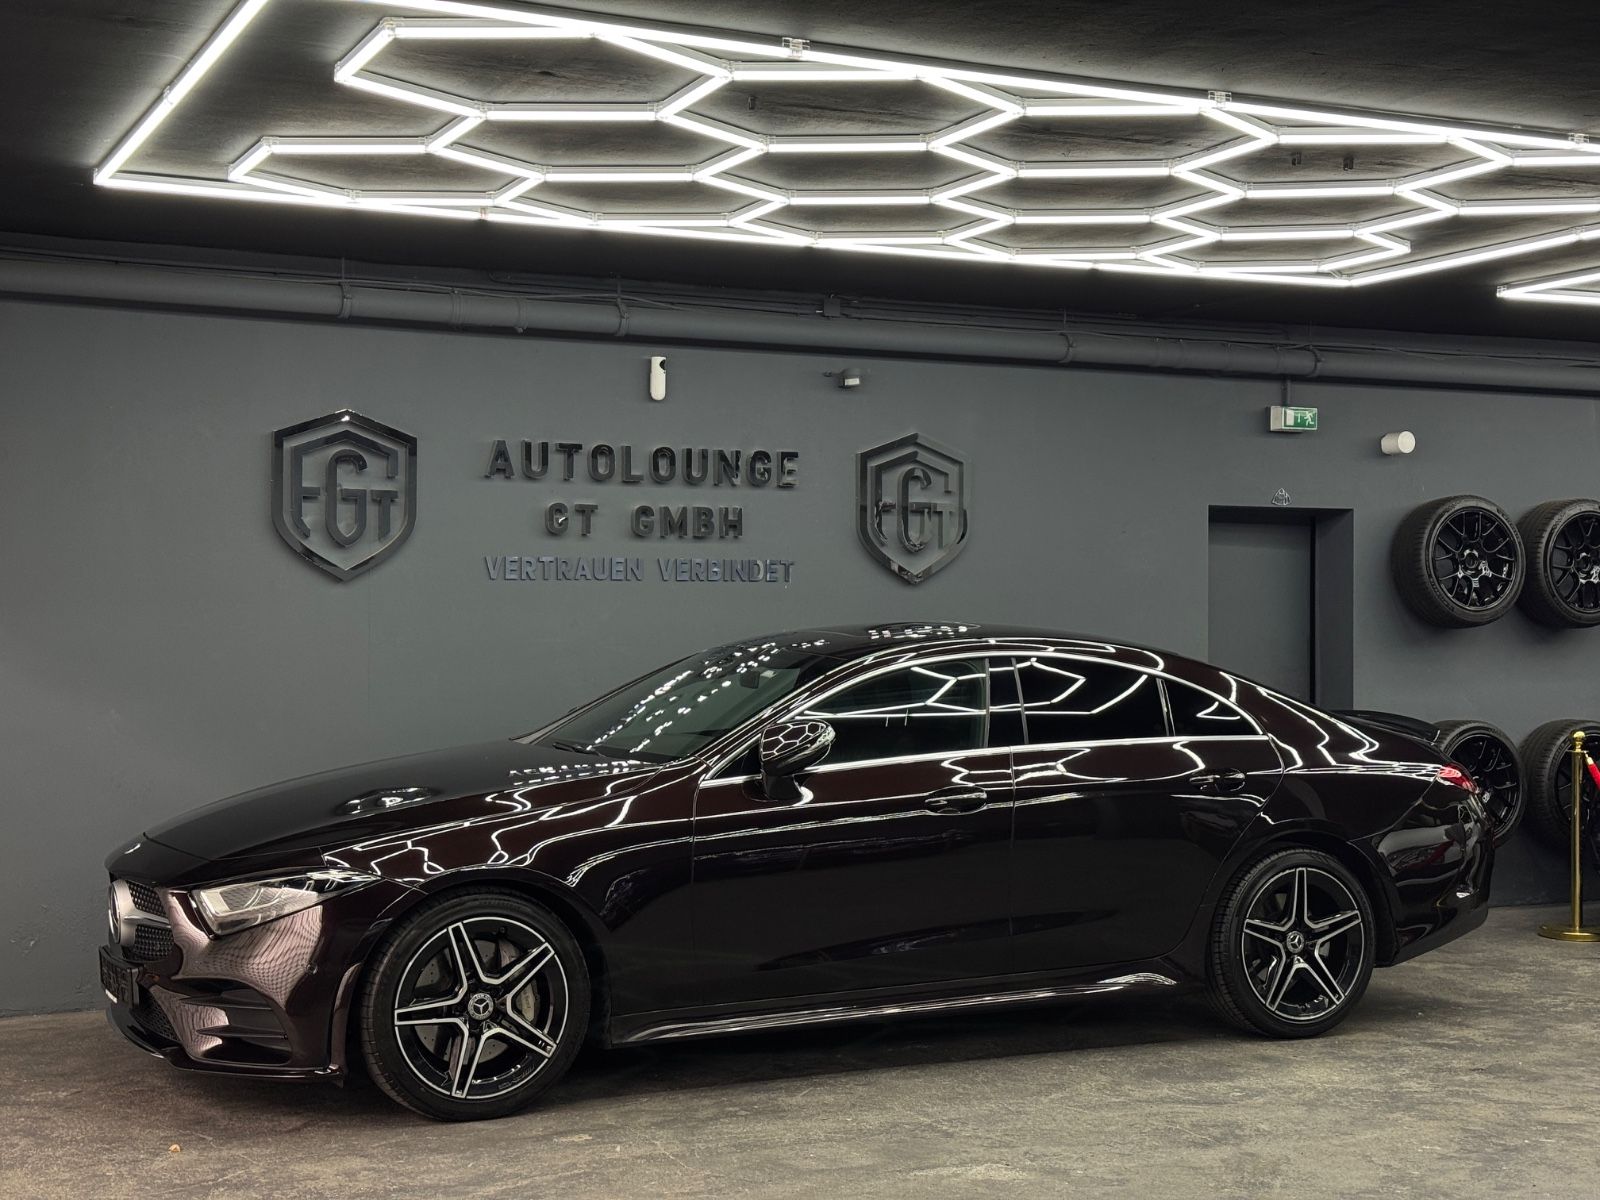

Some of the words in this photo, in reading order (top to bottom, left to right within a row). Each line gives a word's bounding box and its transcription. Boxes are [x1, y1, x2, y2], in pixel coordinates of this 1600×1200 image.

[484, 439, 799, 487] AUTOLOUNGE
[545, 502, 599, 536] GT
[631, 504, 743, 538] GMBH
[485, 555, 643, 582] VERTRAUEN
[657, 557, 794, 583] VERBINDET
